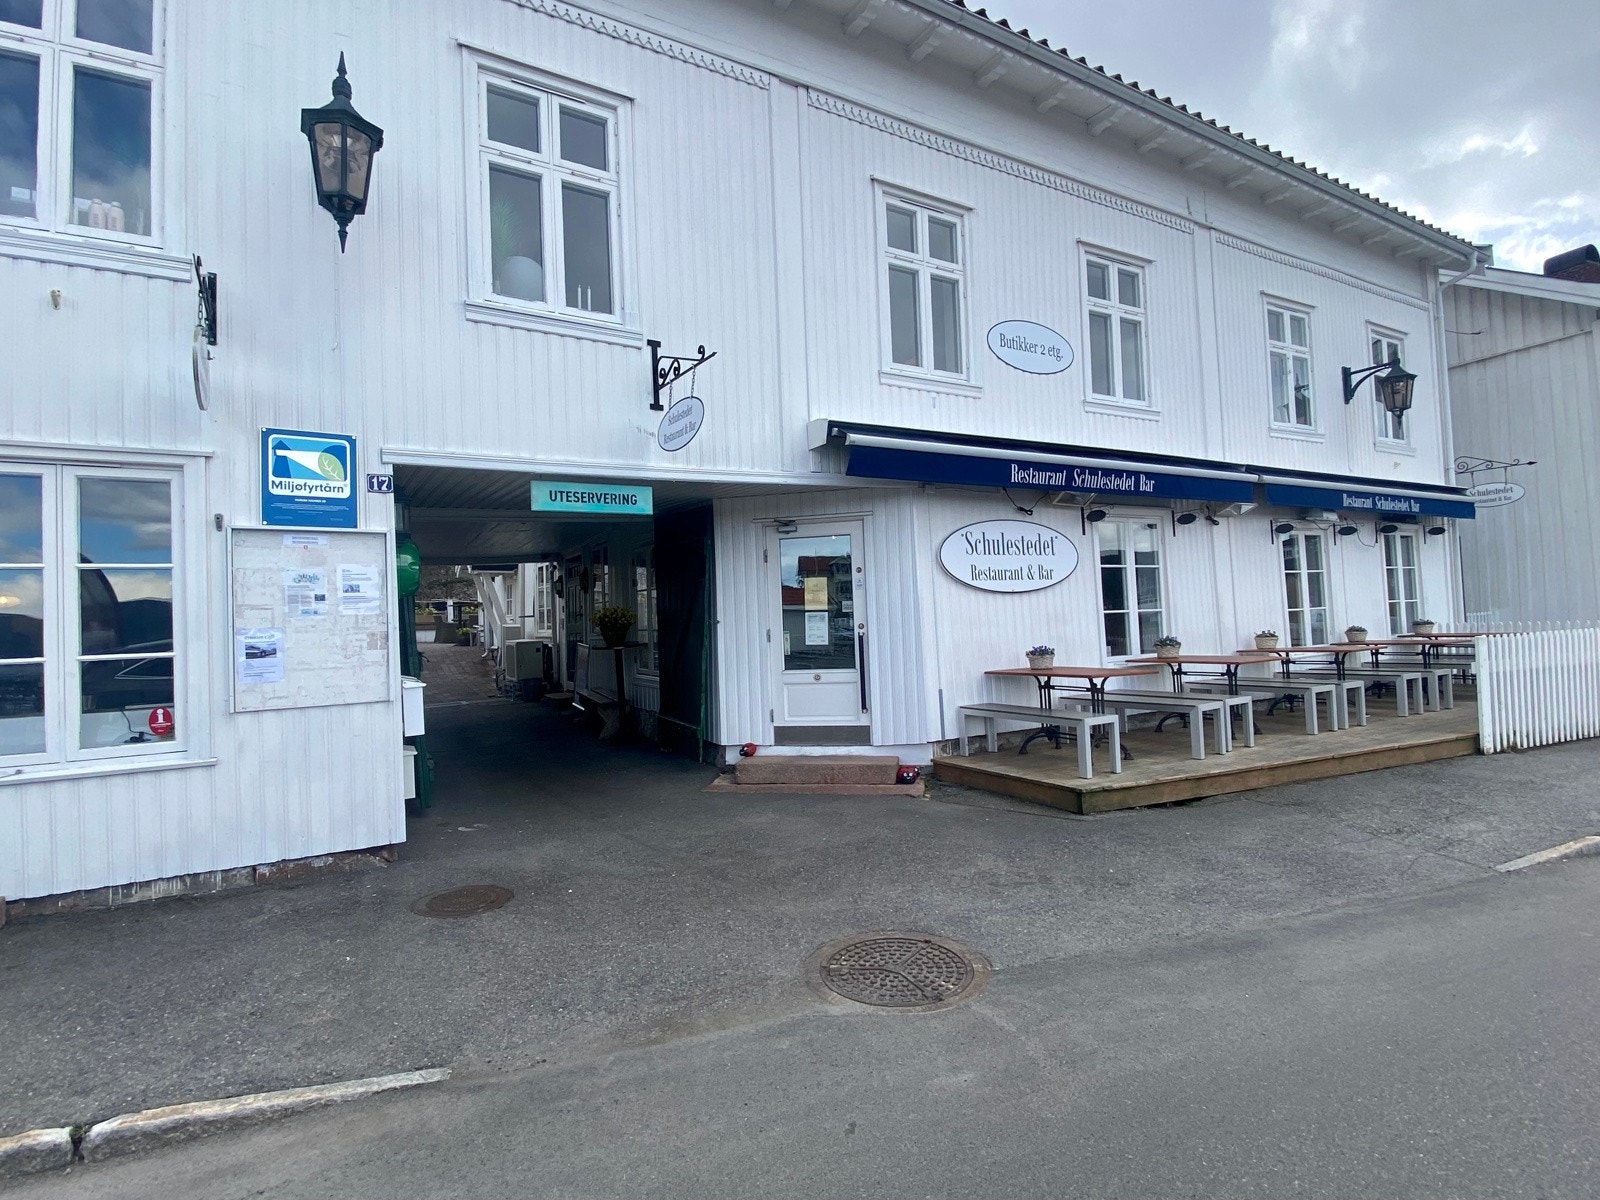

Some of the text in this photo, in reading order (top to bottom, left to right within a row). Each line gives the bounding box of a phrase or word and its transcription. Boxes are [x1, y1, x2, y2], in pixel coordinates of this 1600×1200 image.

[999, 332, 1064, 362] Butikker 2 etg.
[371, 475, 390, 491] 17
[1010, 463, 1155, 492] Restaurant Schulestedet Bar
[271, 480, 344, 494] Miljøfyrtårn
[549, 489, 638, 506] UTESERVERING
[1342, 493, 1420, 512] Restaurant Schulestedet Bar
[970, 564, 1054, 581] Restaurant & Bar
